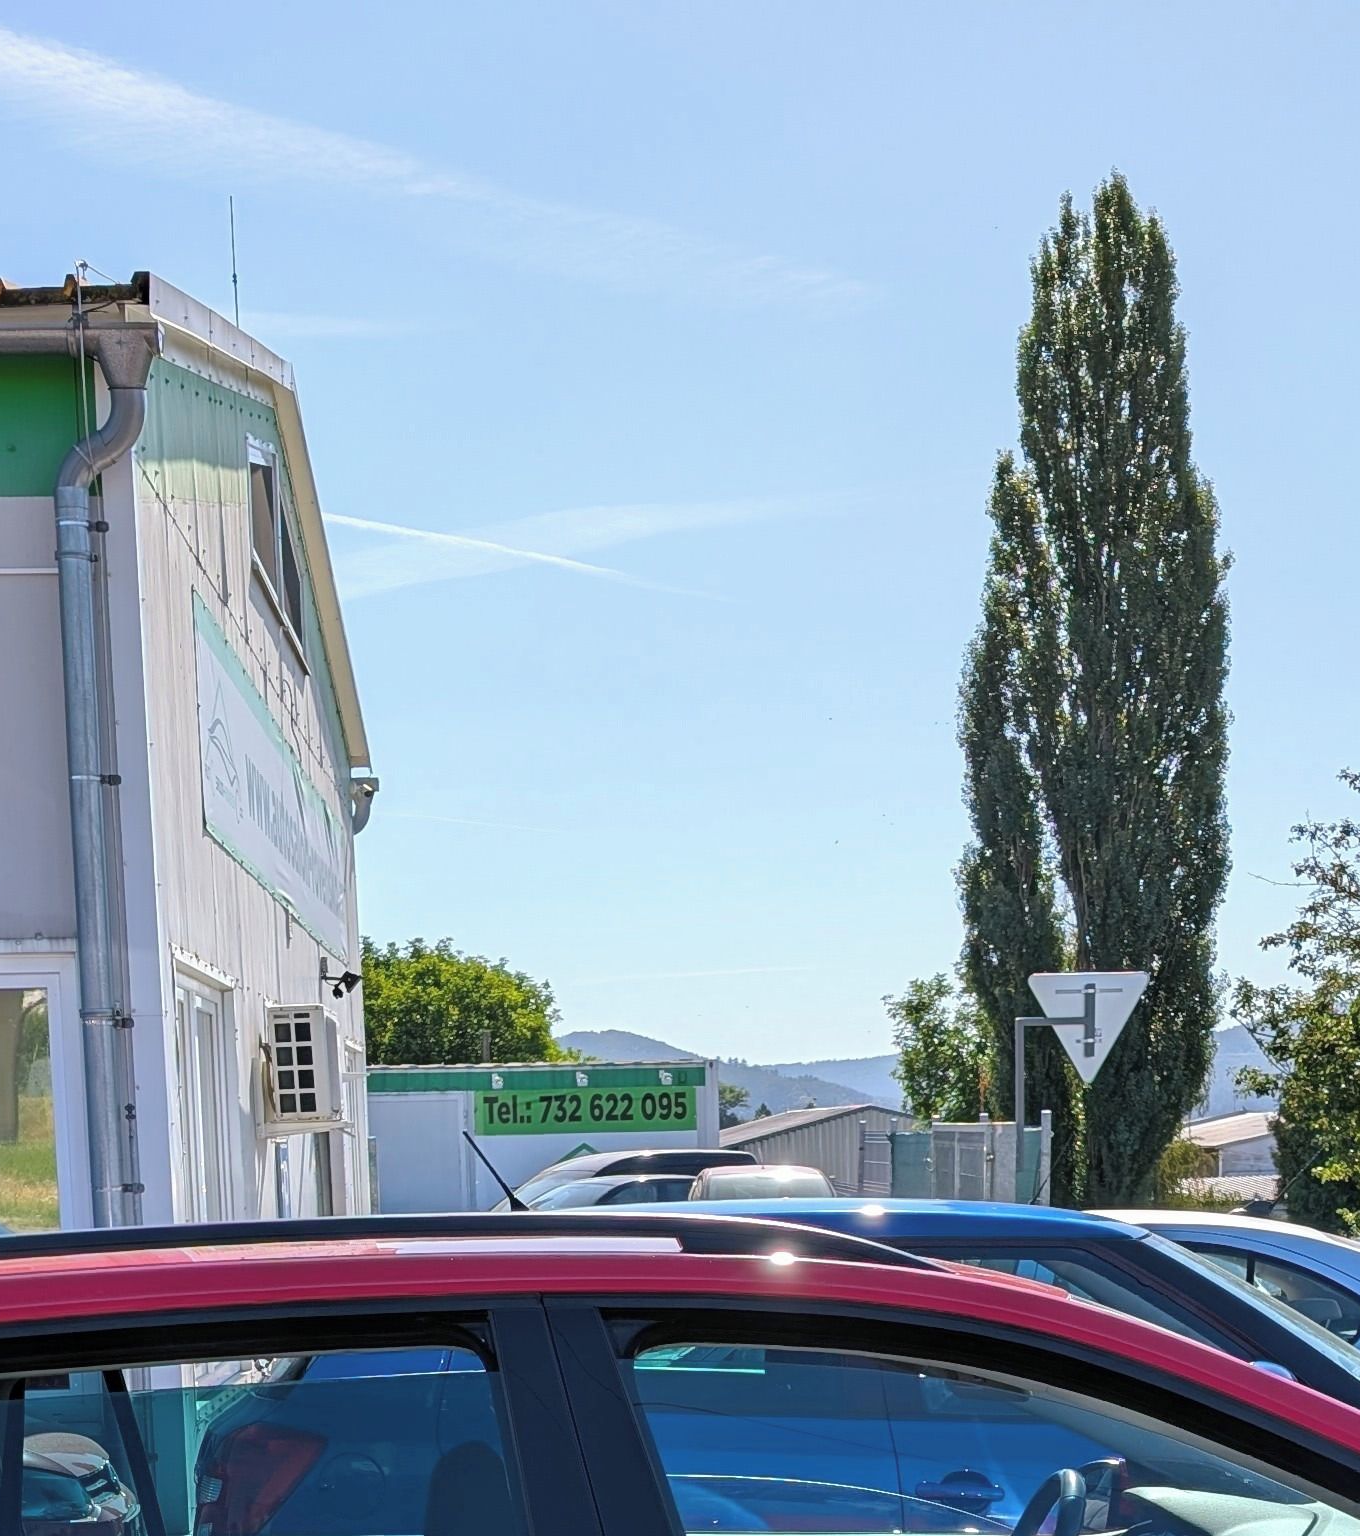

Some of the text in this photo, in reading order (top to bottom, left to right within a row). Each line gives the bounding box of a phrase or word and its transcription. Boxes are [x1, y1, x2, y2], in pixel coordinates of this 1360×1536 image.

[483, 1091, 687, 1125] Tel.: 732 622 095
